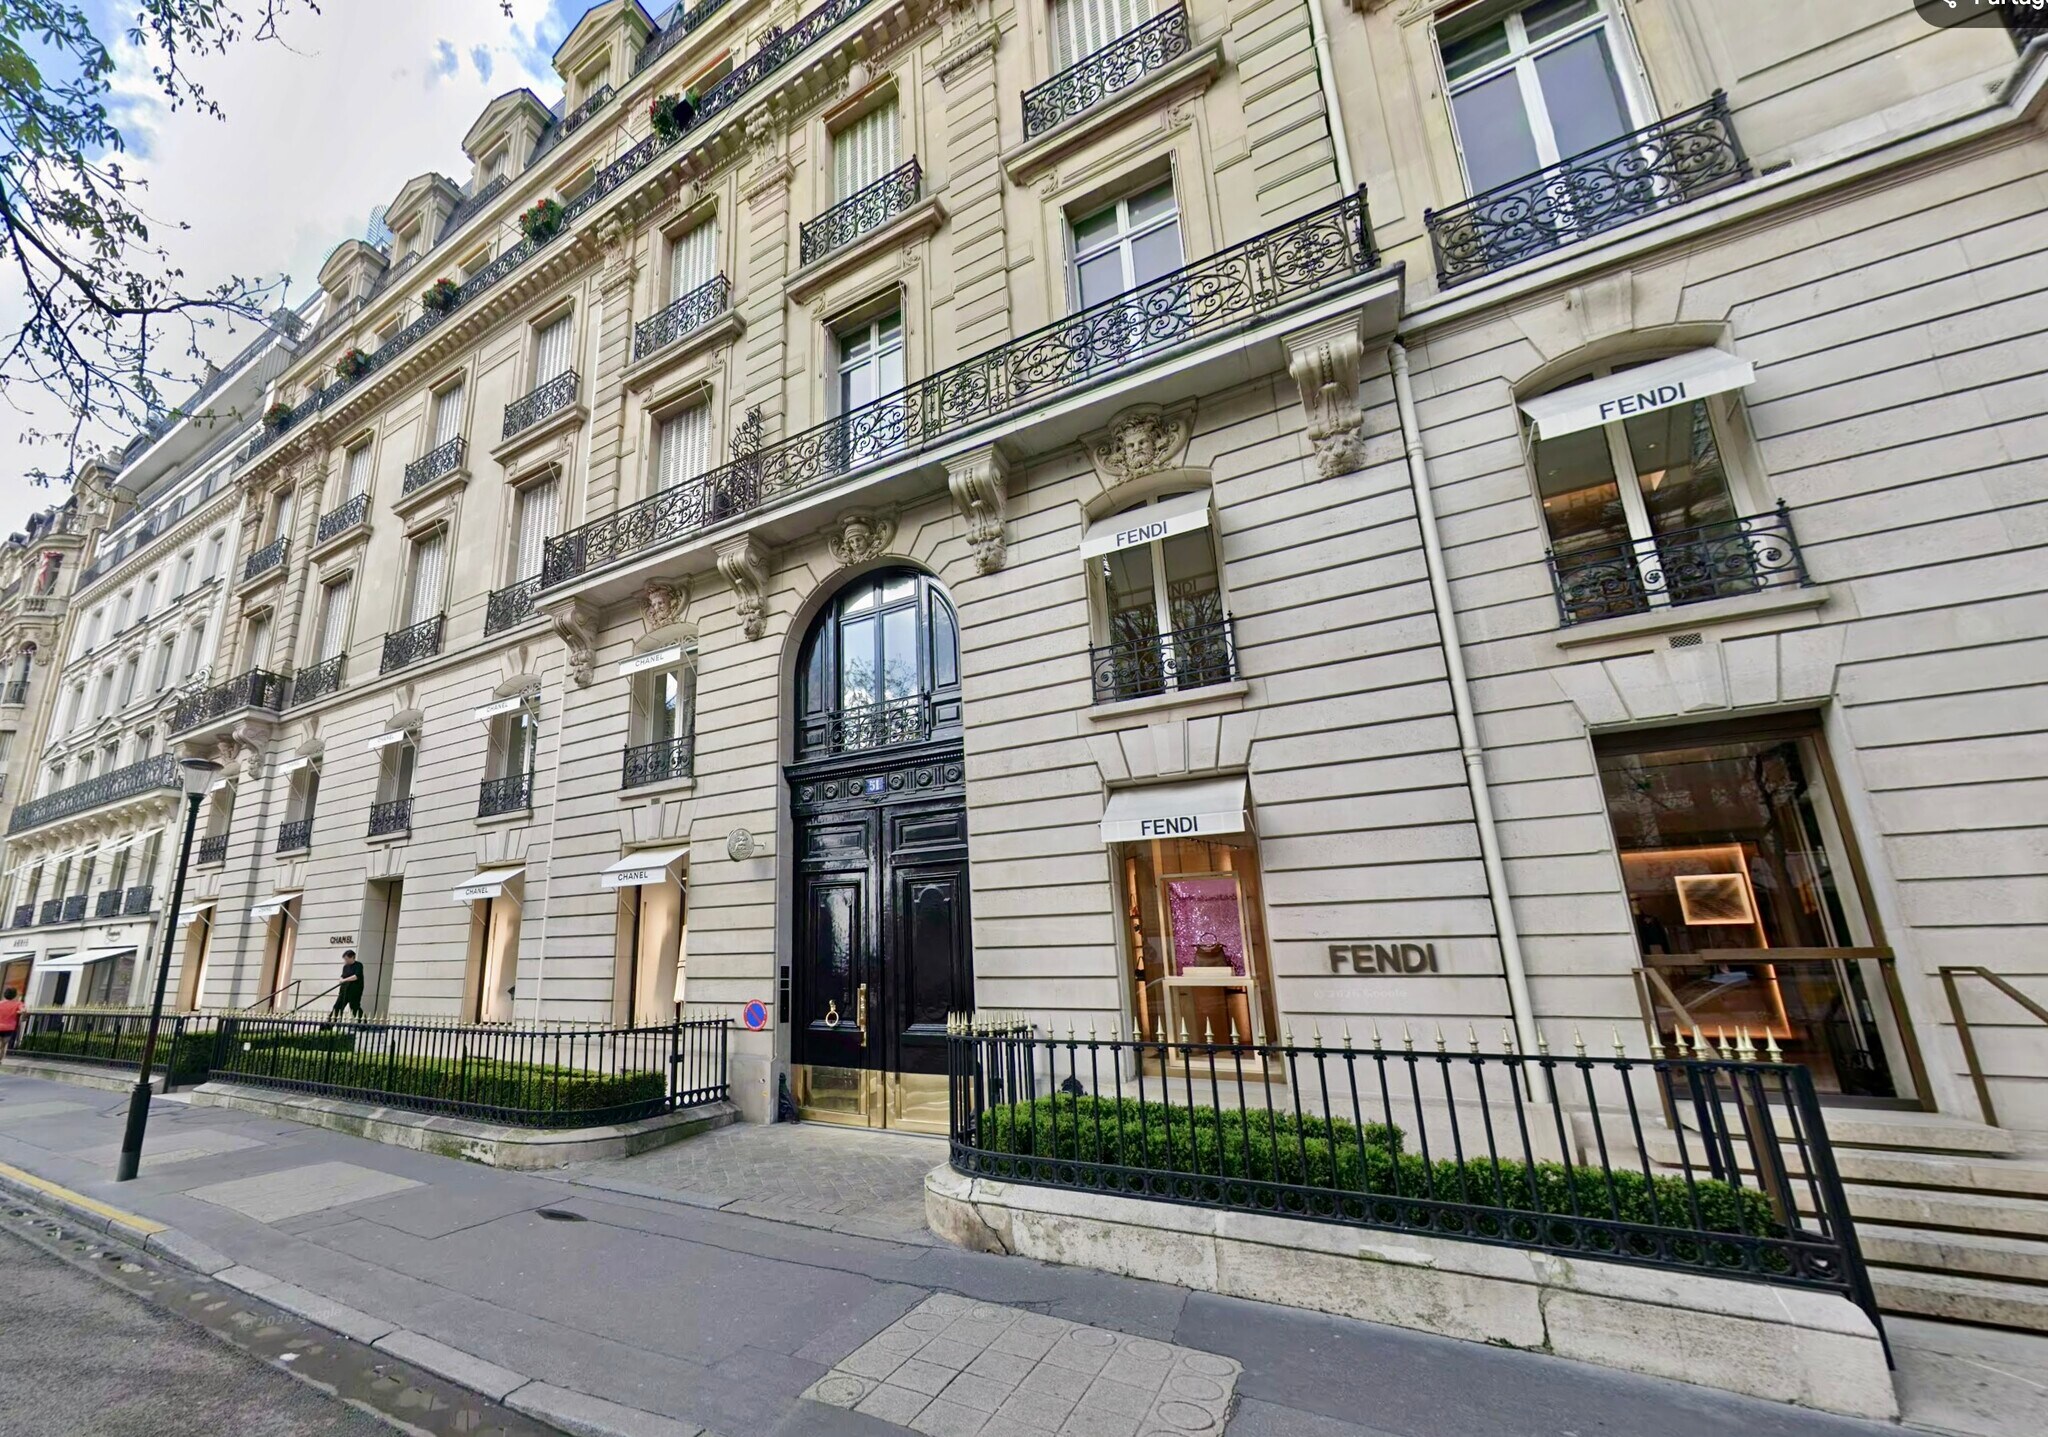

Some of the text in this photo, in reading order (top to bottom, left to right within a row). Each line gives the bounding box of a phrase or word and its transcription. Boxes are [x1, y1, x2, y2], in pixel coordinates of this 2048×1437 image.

[1599, 382, 1687, 420] FENDI
[1116, 521, 1168, 547] FENDI
[634, 653, 665, 668] CHANEL
[868, 780, 880, 791] 51
[1140, 816, 1199, 836] FENDI
[617, 871, 649, 882] CHANEL
[465, 886, 489, 896] CHANEL
[1329, 942, 1439, 974] FENDI
